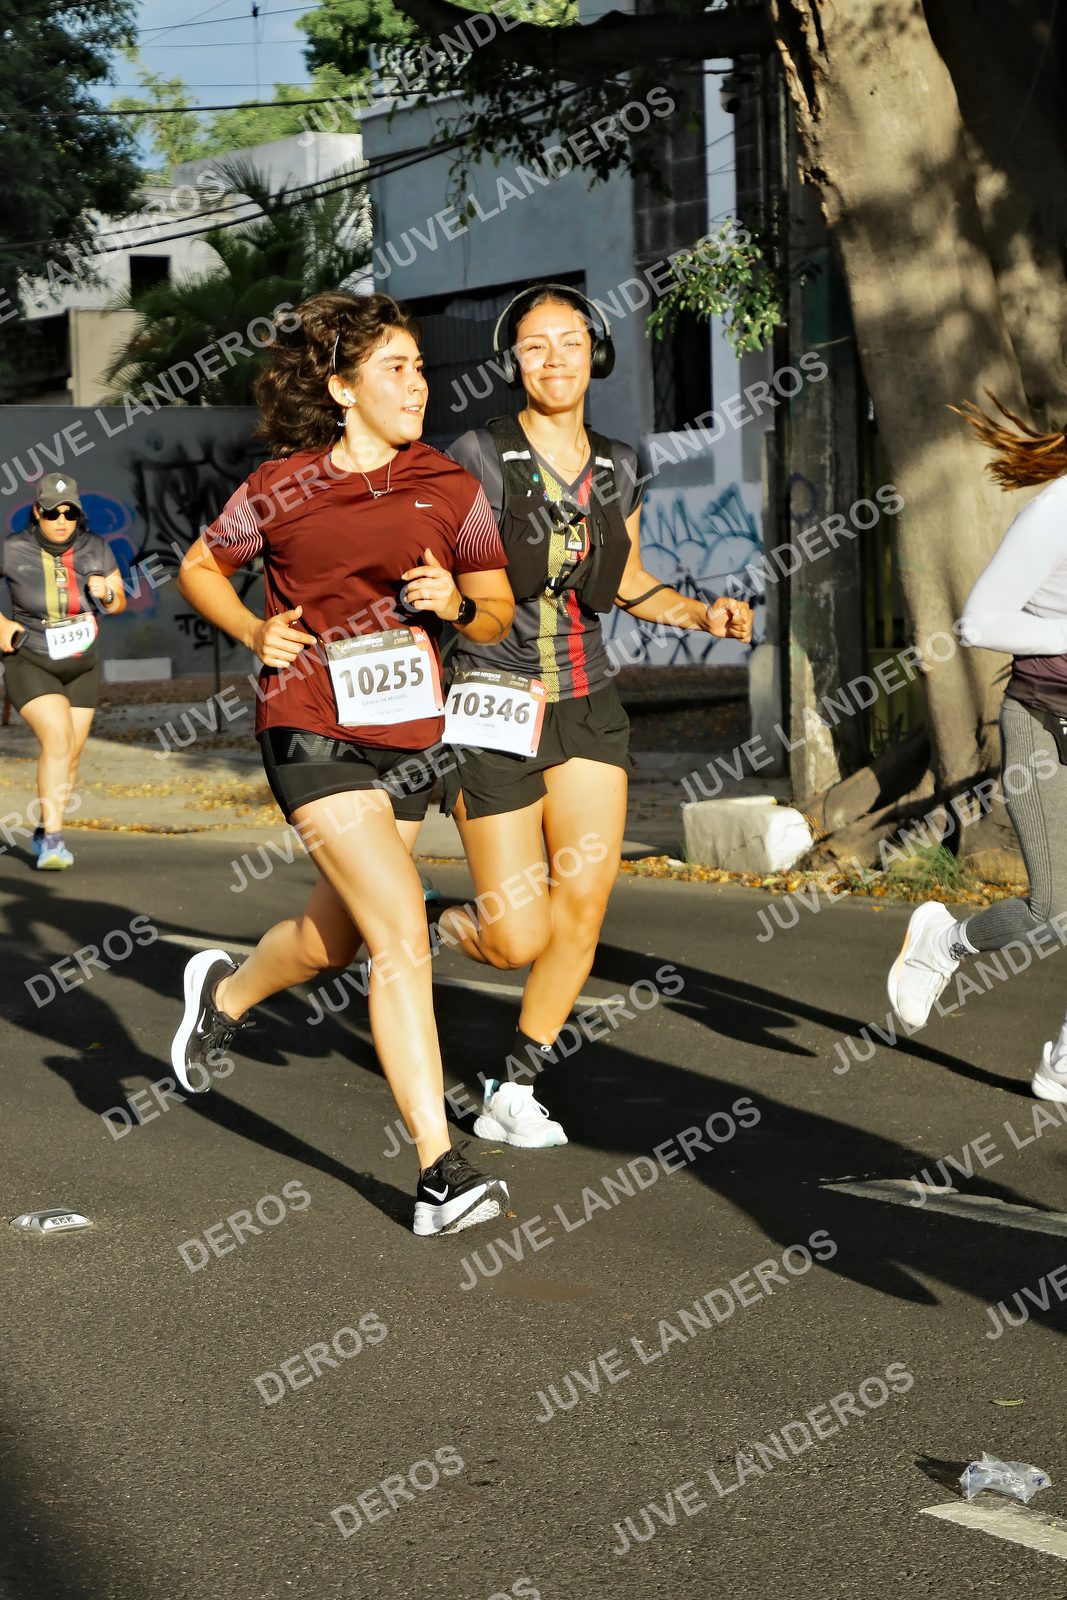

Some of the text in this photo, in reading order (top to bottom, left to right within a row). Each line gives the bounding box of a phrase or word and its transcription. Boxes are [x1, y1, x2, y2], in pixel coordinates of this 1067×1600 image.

[53, 628, 90, 645] 13391
[339, 657, 424, 698] 10255
[451, 691, 530, 724] 10346
